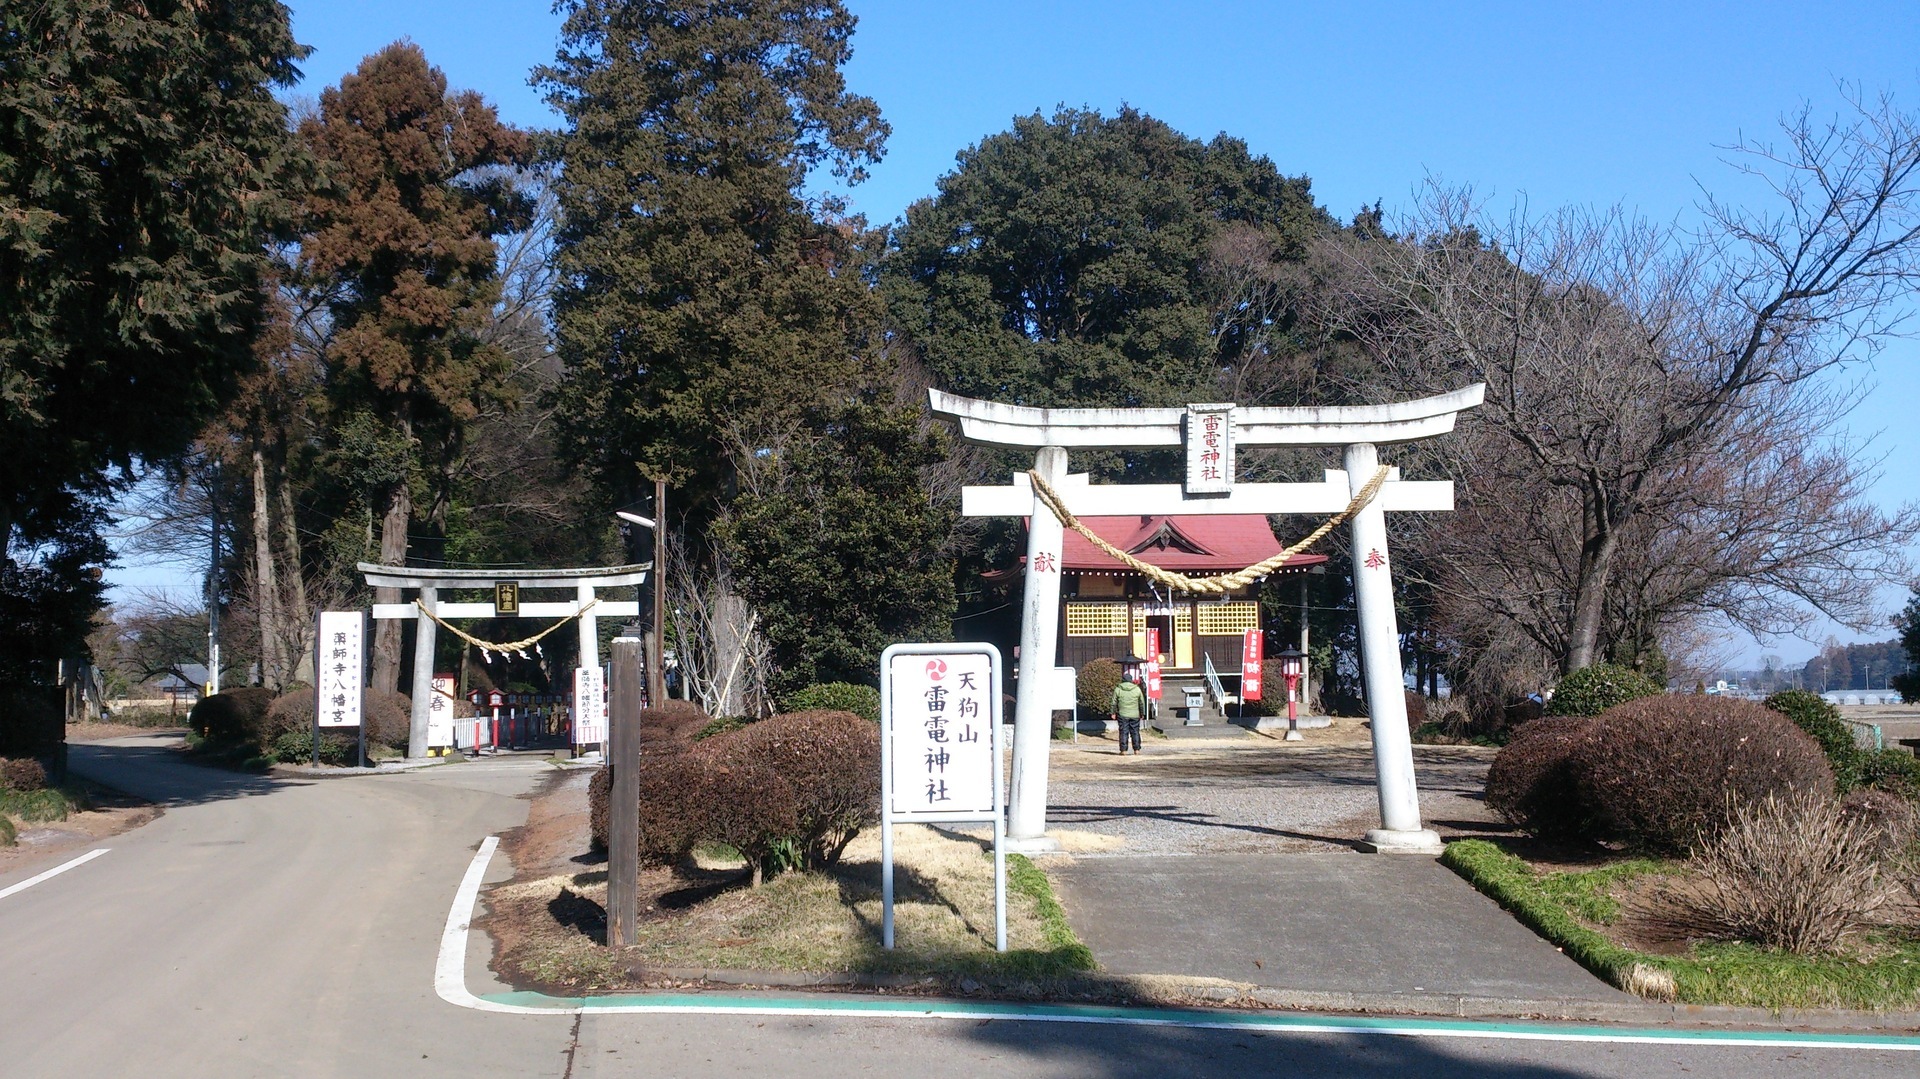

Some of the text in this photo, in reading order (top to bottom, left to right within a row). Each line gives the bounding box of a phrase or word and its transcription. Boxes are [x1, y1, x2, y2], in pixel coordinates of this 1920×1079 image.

[1200, 415, 1222, 481] 雷電神社
[1034, 551, 1056, 573] 献
[1364, 548, 1386, 571] 奉
[331, 631, 347, 723] 薬師寺八幡宮
[957, 671, 979, 744] 天狗山
[924, 685, 951, 804] 雷電神社
